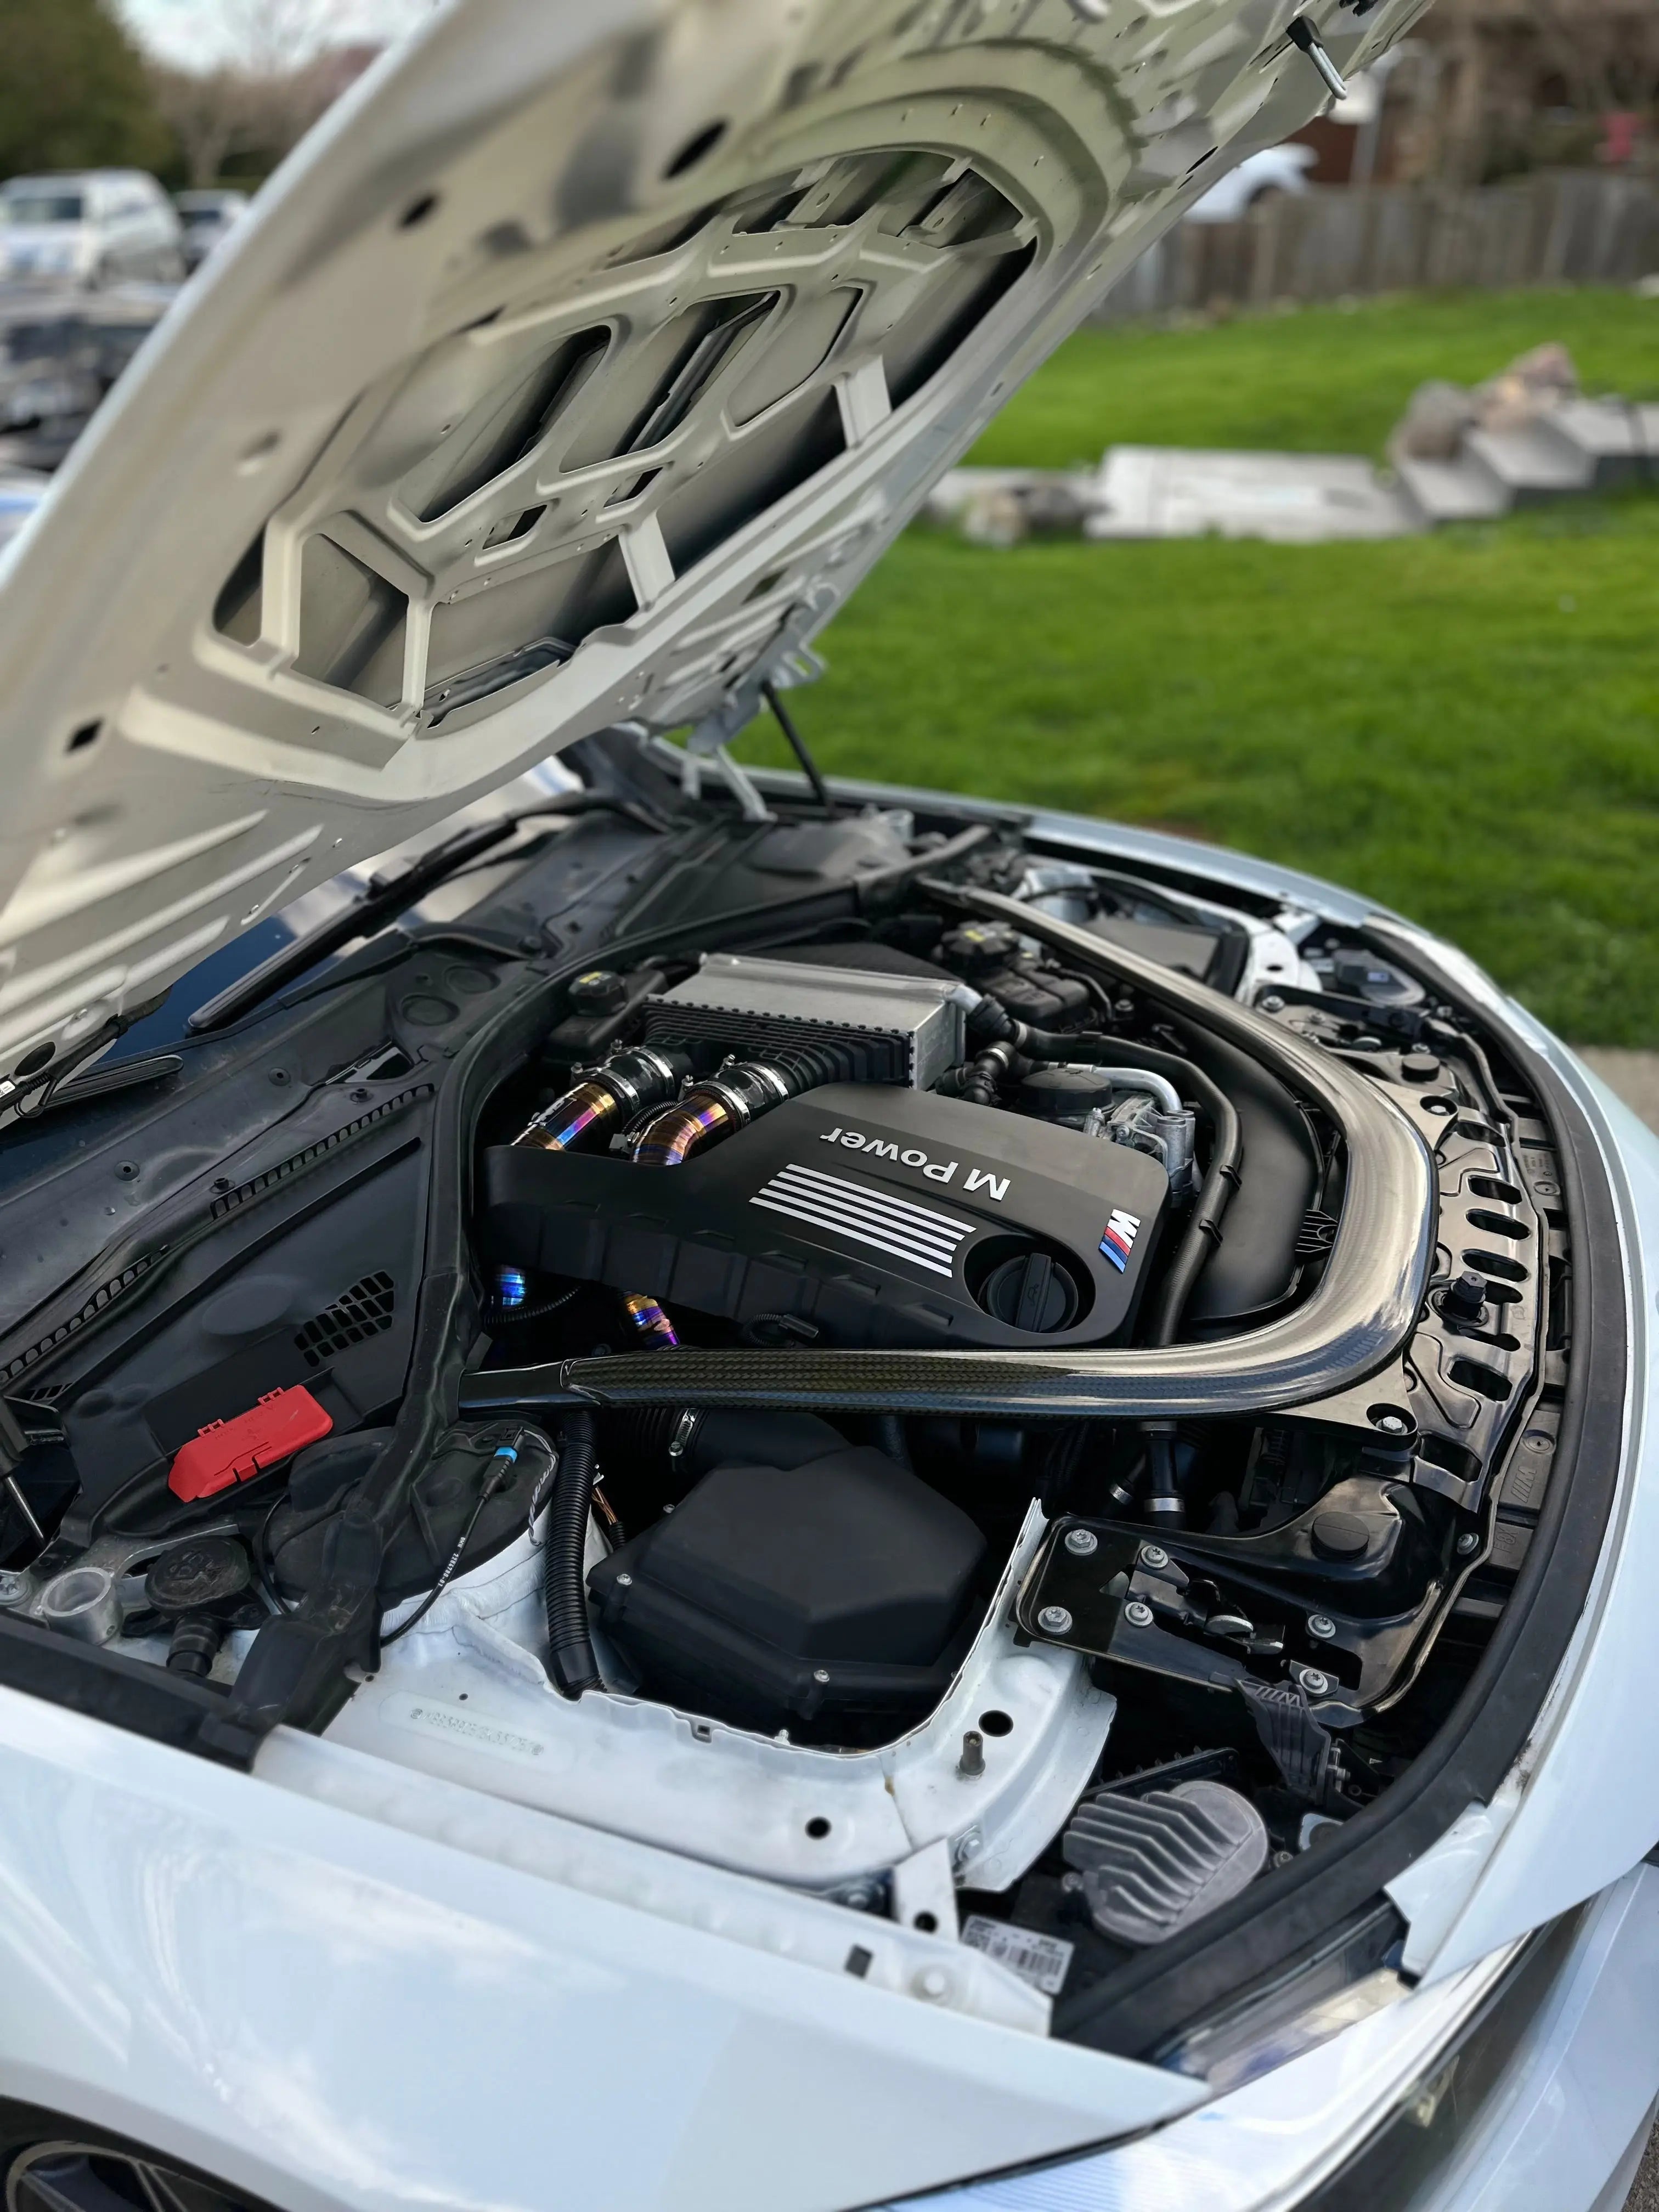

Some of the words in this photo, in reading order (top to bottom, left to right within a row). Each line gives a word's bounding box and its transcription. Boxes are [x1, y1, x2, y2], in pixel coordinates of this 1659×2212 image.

[819, 1127, 960, 1184] Power
[962, 1167, 1011, 1201] M
[457, 1537, 466, 1548] BMW
